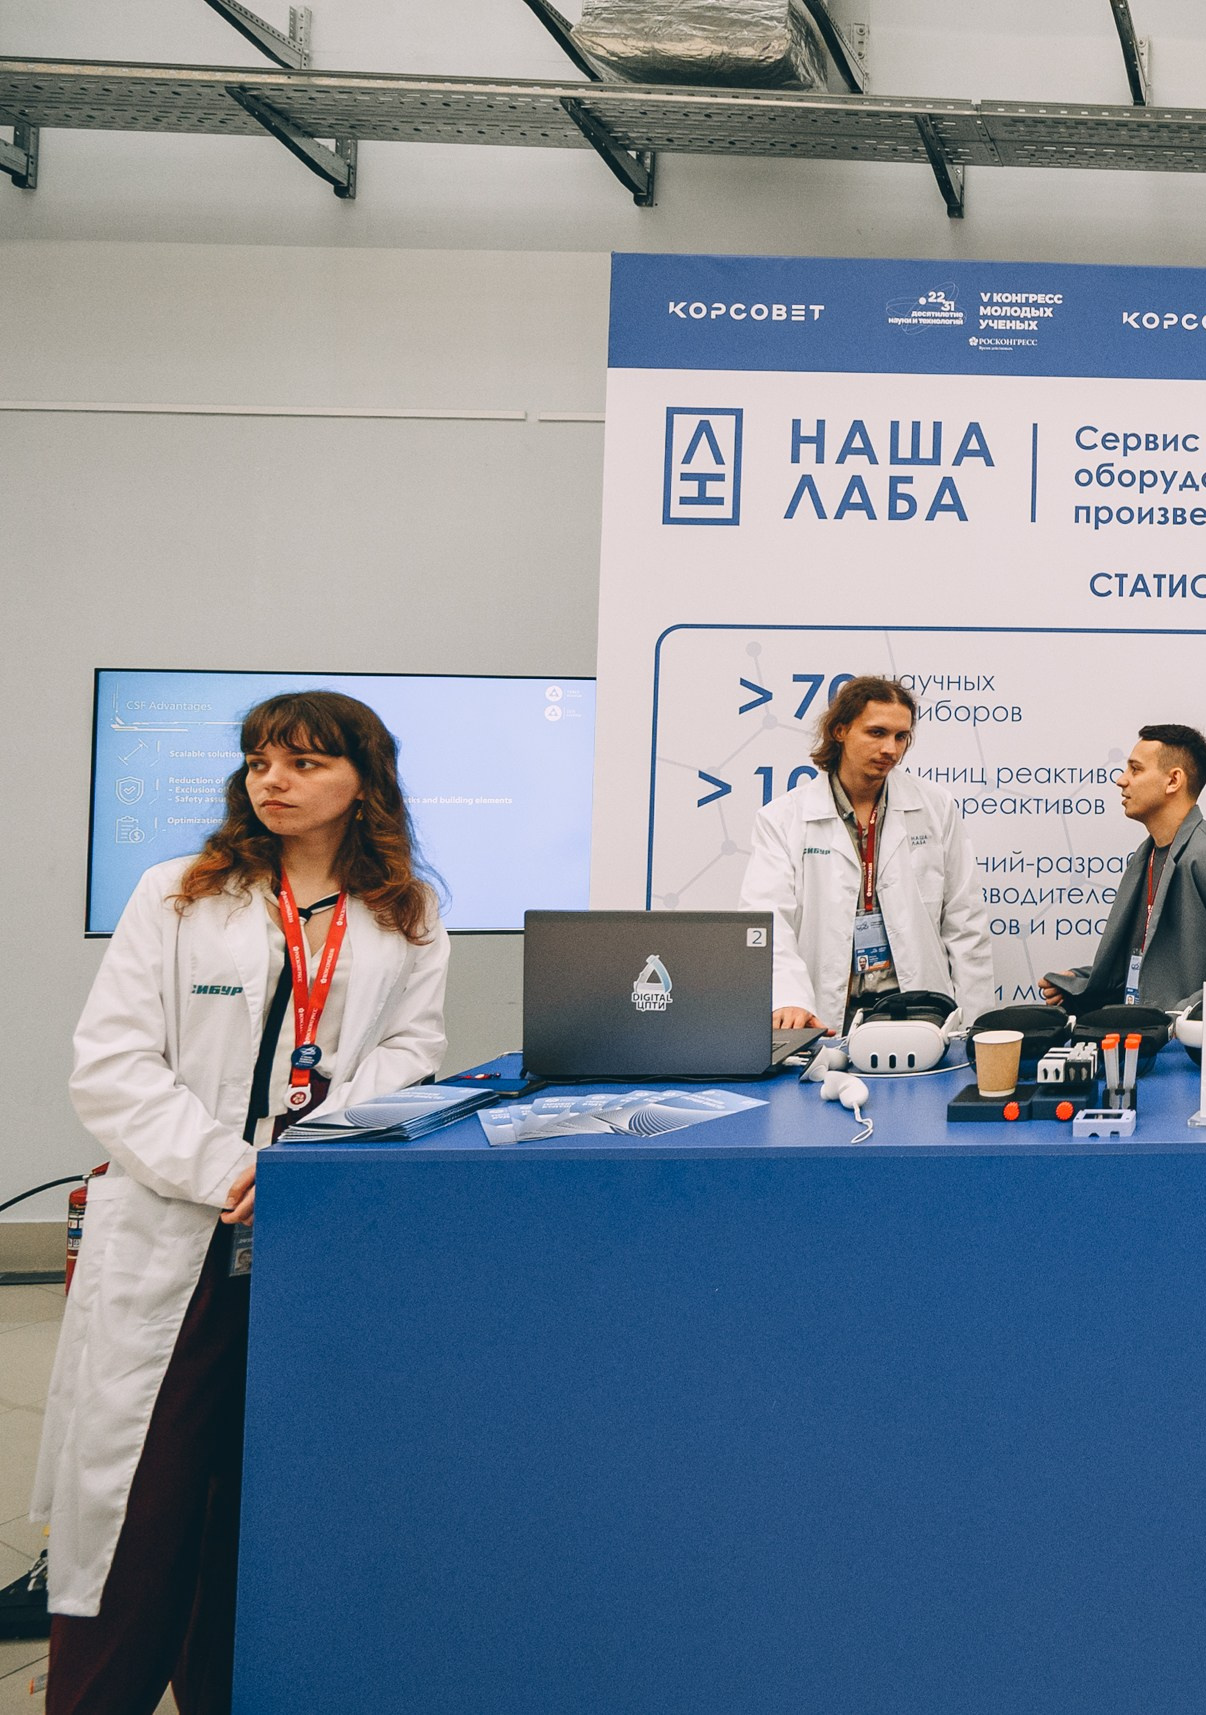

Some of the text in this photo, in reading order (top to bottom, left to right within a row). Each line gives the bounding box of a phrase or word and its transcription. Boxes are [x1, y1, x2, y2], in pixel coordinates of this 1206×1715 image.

[928, 291, 945, 303] 22
[980, 292, 1063, 304] V КОНГРЕСС
[667, 301, 825, 322] КОРСОВЕТ
[941, 301, 954, 311] 31
[979, 306, 1053, 318] МОЛОДЫХ
[979, 319, 1038, 331] УЧЕНЫХ
[979, 338, 1038, 346] РОСКОНГРЕСС
[790, 418, 996, 468] НАША
[1075, 425, 1200, 457] Сервис
[783, 473, 969, 522] ЛАБА
[126, 701, 213, 712] CSF Advantages
[917, 699, 1023, 728] иборов
[169, 750, 205, 758] Scalable
[169, 777, 213, 785] Reduction
[905, 766, 1123, 789] иниц реактиво
[175, 786, 216, 794] Exclusion
[175, 796, 203, 804] Safety
[439, 796, 473, 806] building
[475, 796, 513, 804] elements
[954, 797, 1106, 820] реактивов
[976, 850, 1134, 878] ний-разра
[982, 887, 1117, 906] водителе
[989, 918, 1021, 936] ов
[1030, 918, 1045, 935] и
[1055, 918, 1108, 941] рас
[752, 930, 762, 945] 2
[632, 993, 672, 1003] DIGITAL
[637, 1002, 666, 1011] ЦПТИ
